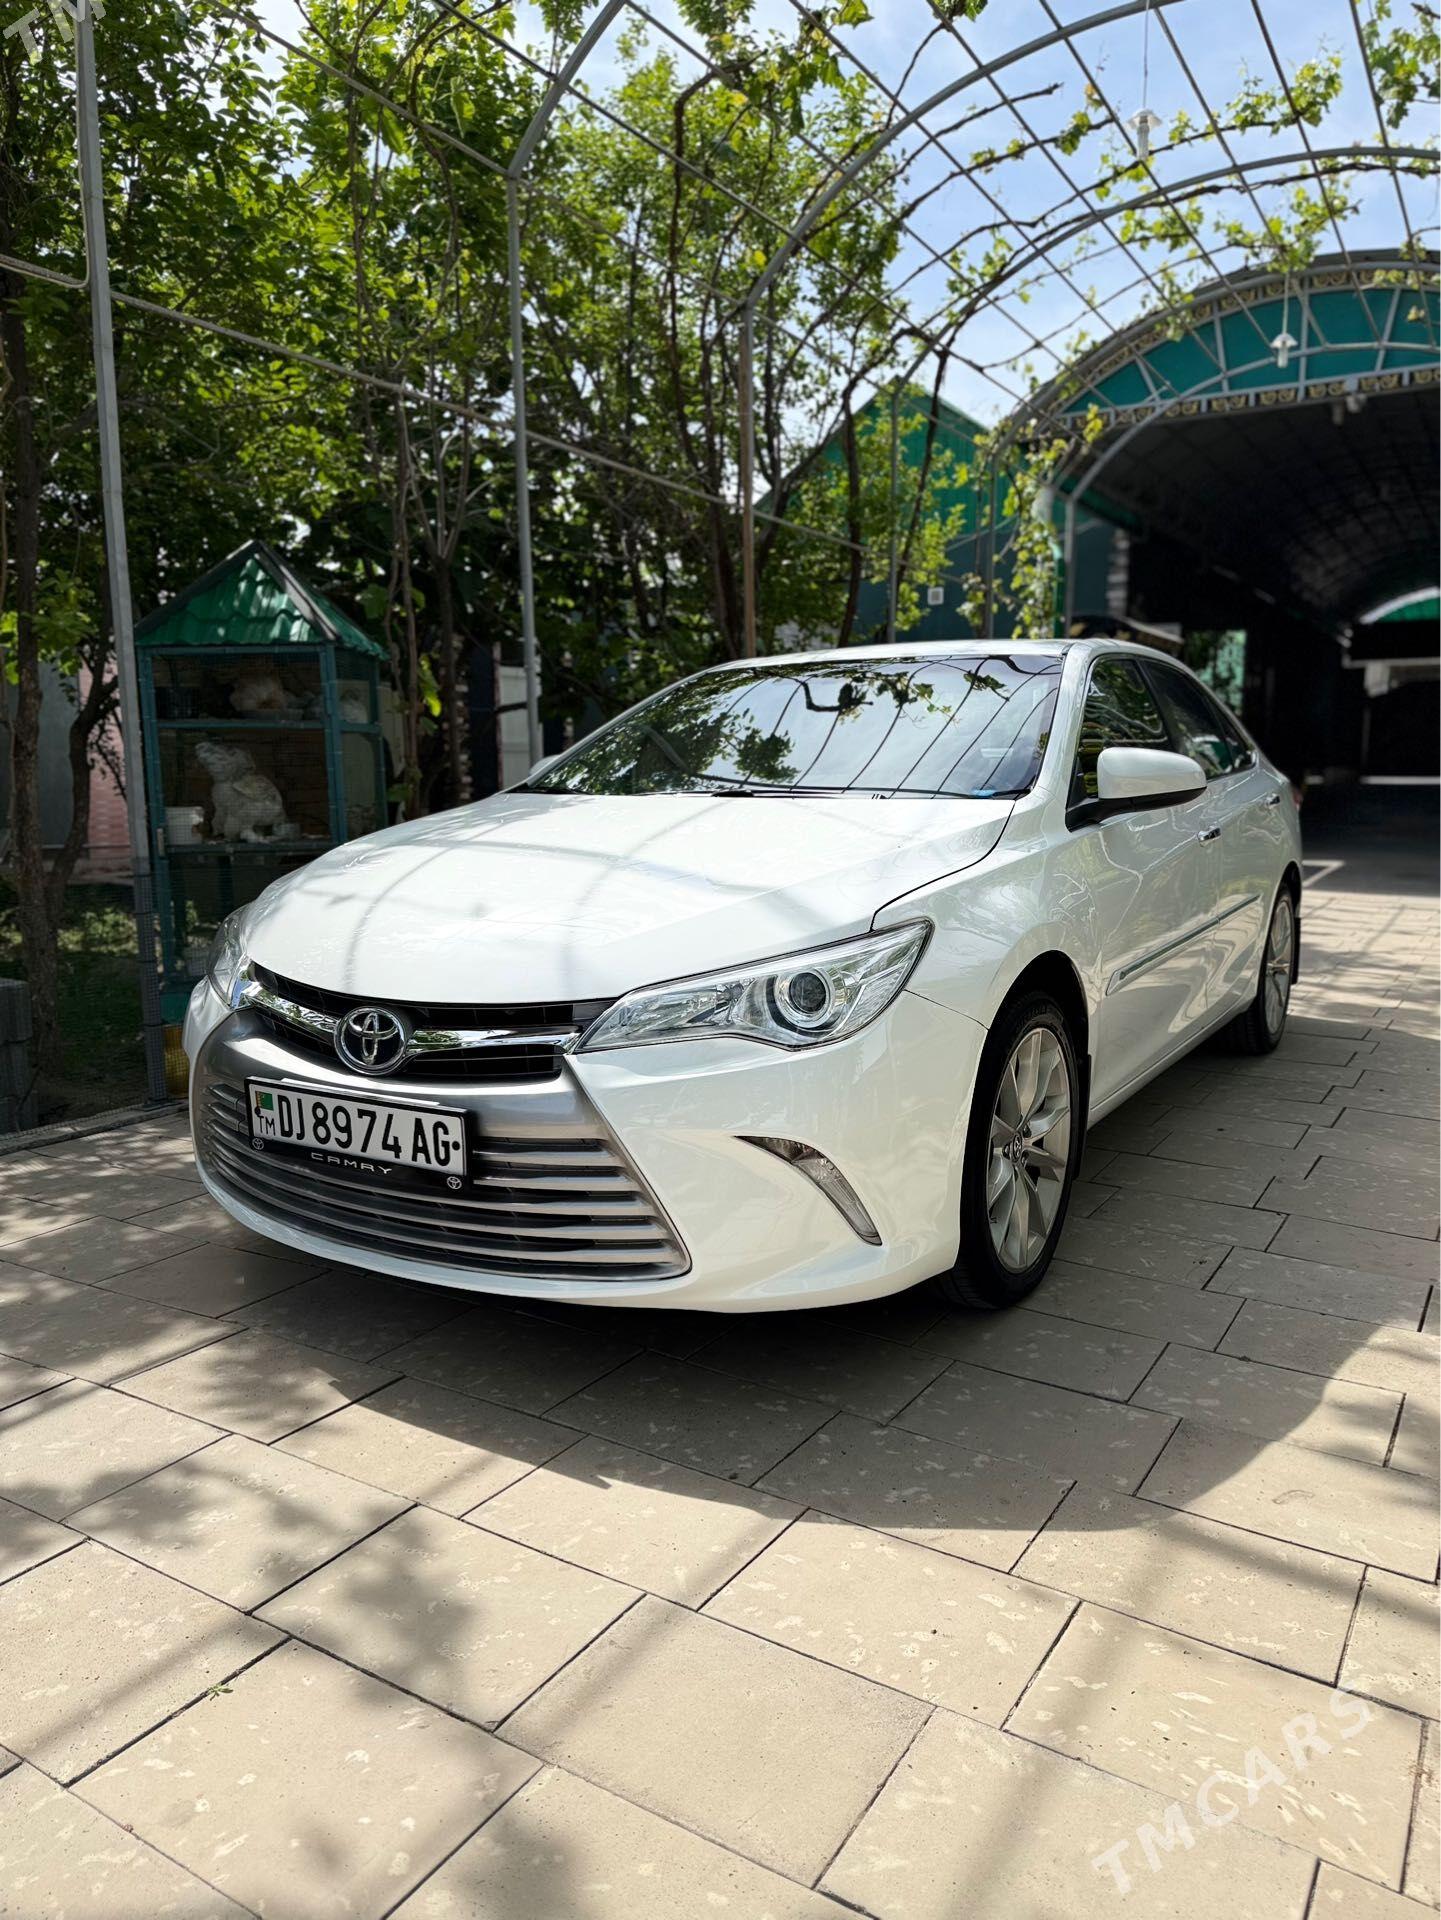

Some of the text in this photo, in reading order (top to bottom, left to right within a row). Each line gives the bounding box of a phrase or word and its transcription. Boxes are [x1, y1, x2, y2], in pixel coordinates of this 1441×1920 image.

[257, 1115, 276, 1136] TM
[277, 1094, 450, 1167] DJ 8974 AG
[311, 1151, 393, 1175] CAMRY
